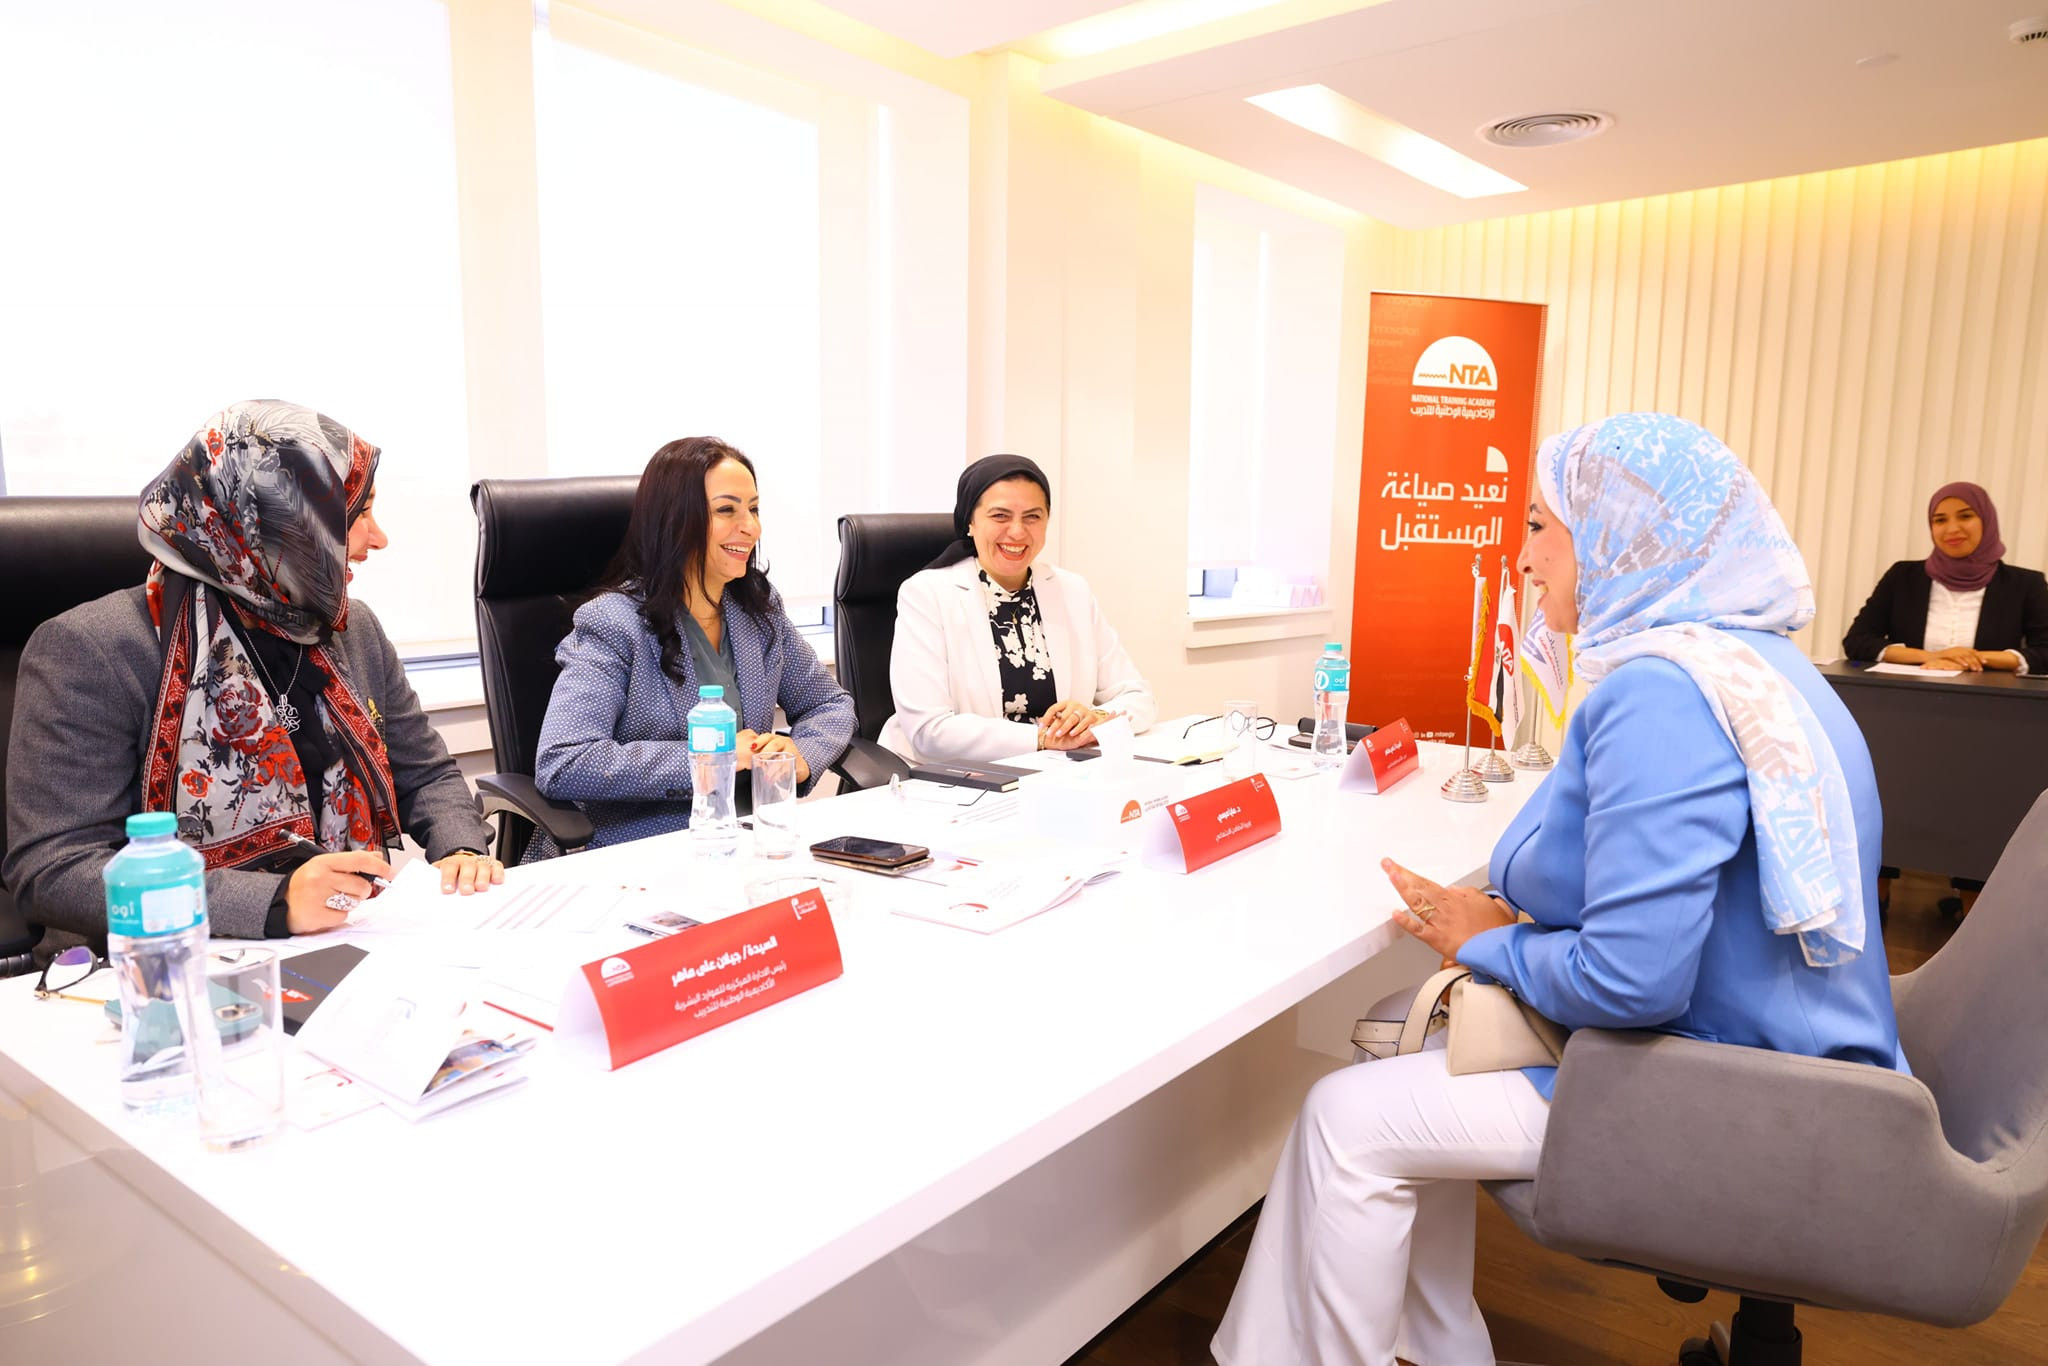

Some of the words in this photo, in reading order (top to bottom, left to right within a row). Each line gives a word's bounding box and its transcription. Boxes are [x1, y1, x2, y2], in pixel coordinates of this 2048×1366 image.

[1449, 363, 1492, 386] NTA
[1411, 394, 1439, 403] NATIONAL
[1440, 395, 1467, 405] TRAINING
[1468, 397, 1496, 407] ACADEMY
[1381, 471, 1454, 507] صياغة
[1461, 476, 1508, 509] نعيد
[1381, 512, 1502, 551] المستقبل
[671, 966, 697, 988] ماهر
[770, 960, 788, 976] رئيس
[693, 1001, 720, 1019] للتدريب
[719, 991, 745, 1009] الوطنية
